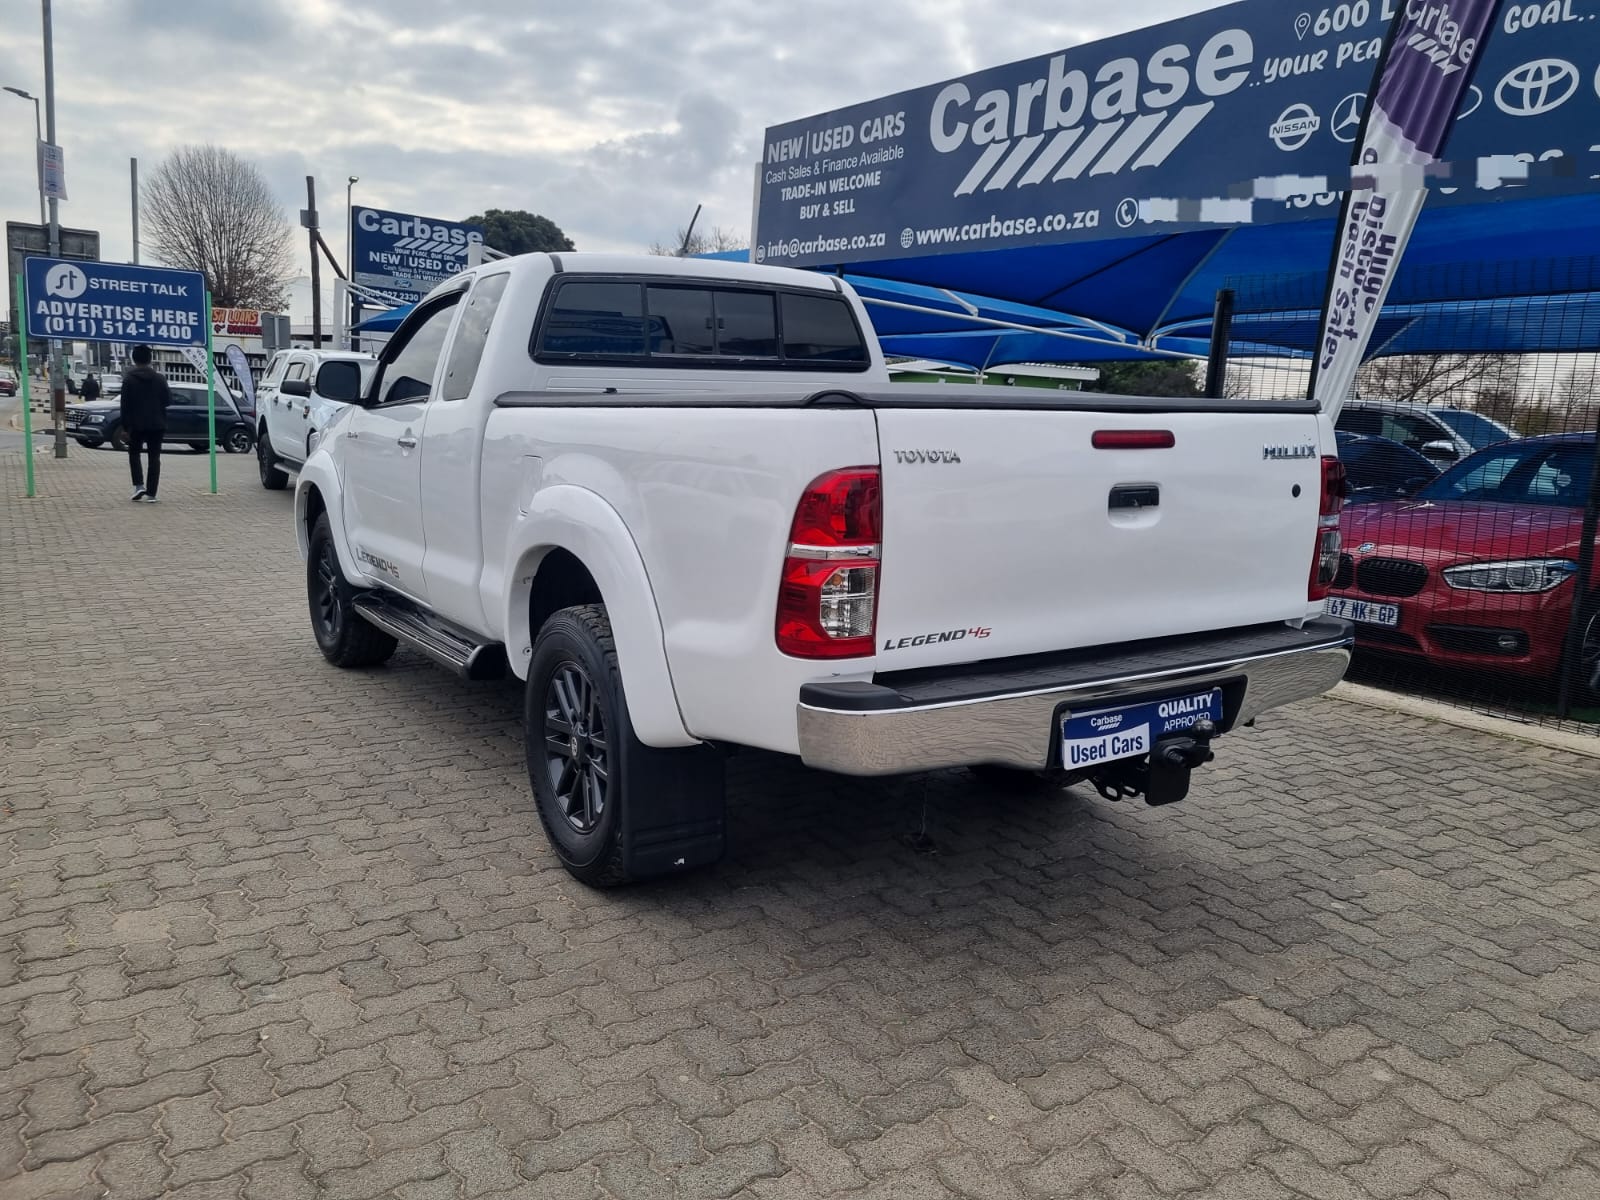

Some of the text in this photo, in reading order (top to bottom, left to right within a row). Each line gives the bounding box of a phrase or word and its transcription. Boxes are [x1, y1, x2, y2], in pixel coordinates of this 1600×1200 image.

[1313, 0, 1370, 37] 600
[929, 28, 1254, 153] Carbase
[767, 111, 906, 164] NEW USED CARS
[1272, 118, 1317, 135] NISSAN
[765, 145, 904, 184] Cash Sales & Finance Available
[781, 170, 881, 201] TRADE-IN WELCOME
[799, 198, 856, 219] BUY & SELL
[358, 210, 484, 245] Carbase
[915, 209, 1100, 245] www.carbase.co.za
[767, 232, 886, 258] info@carbase.co.za
[369, 251, 401, 265] NEW
[408, 257, 442, 270] USED
[89, 277, 148, 293] STREET
[151, 283, 188, 297] TALK
[36, 300, 199, 326] ADVERTISE HERE
[228, 310, 259, 325] LOANS
[45, 316, 97, 336] (011)
[103, 320, 192, 340] 514-1400
[893, 448, 961, 464] TOYOTA
[1263, 443, 1316, 460] HILUX
[1331, 600, 1346, 615] 67
[1379, 606, 1395, 623] GP
[1090, 693, 1213, 727] Carbase QUALITY
[1070, 735, 1143, 765] Used Cars
